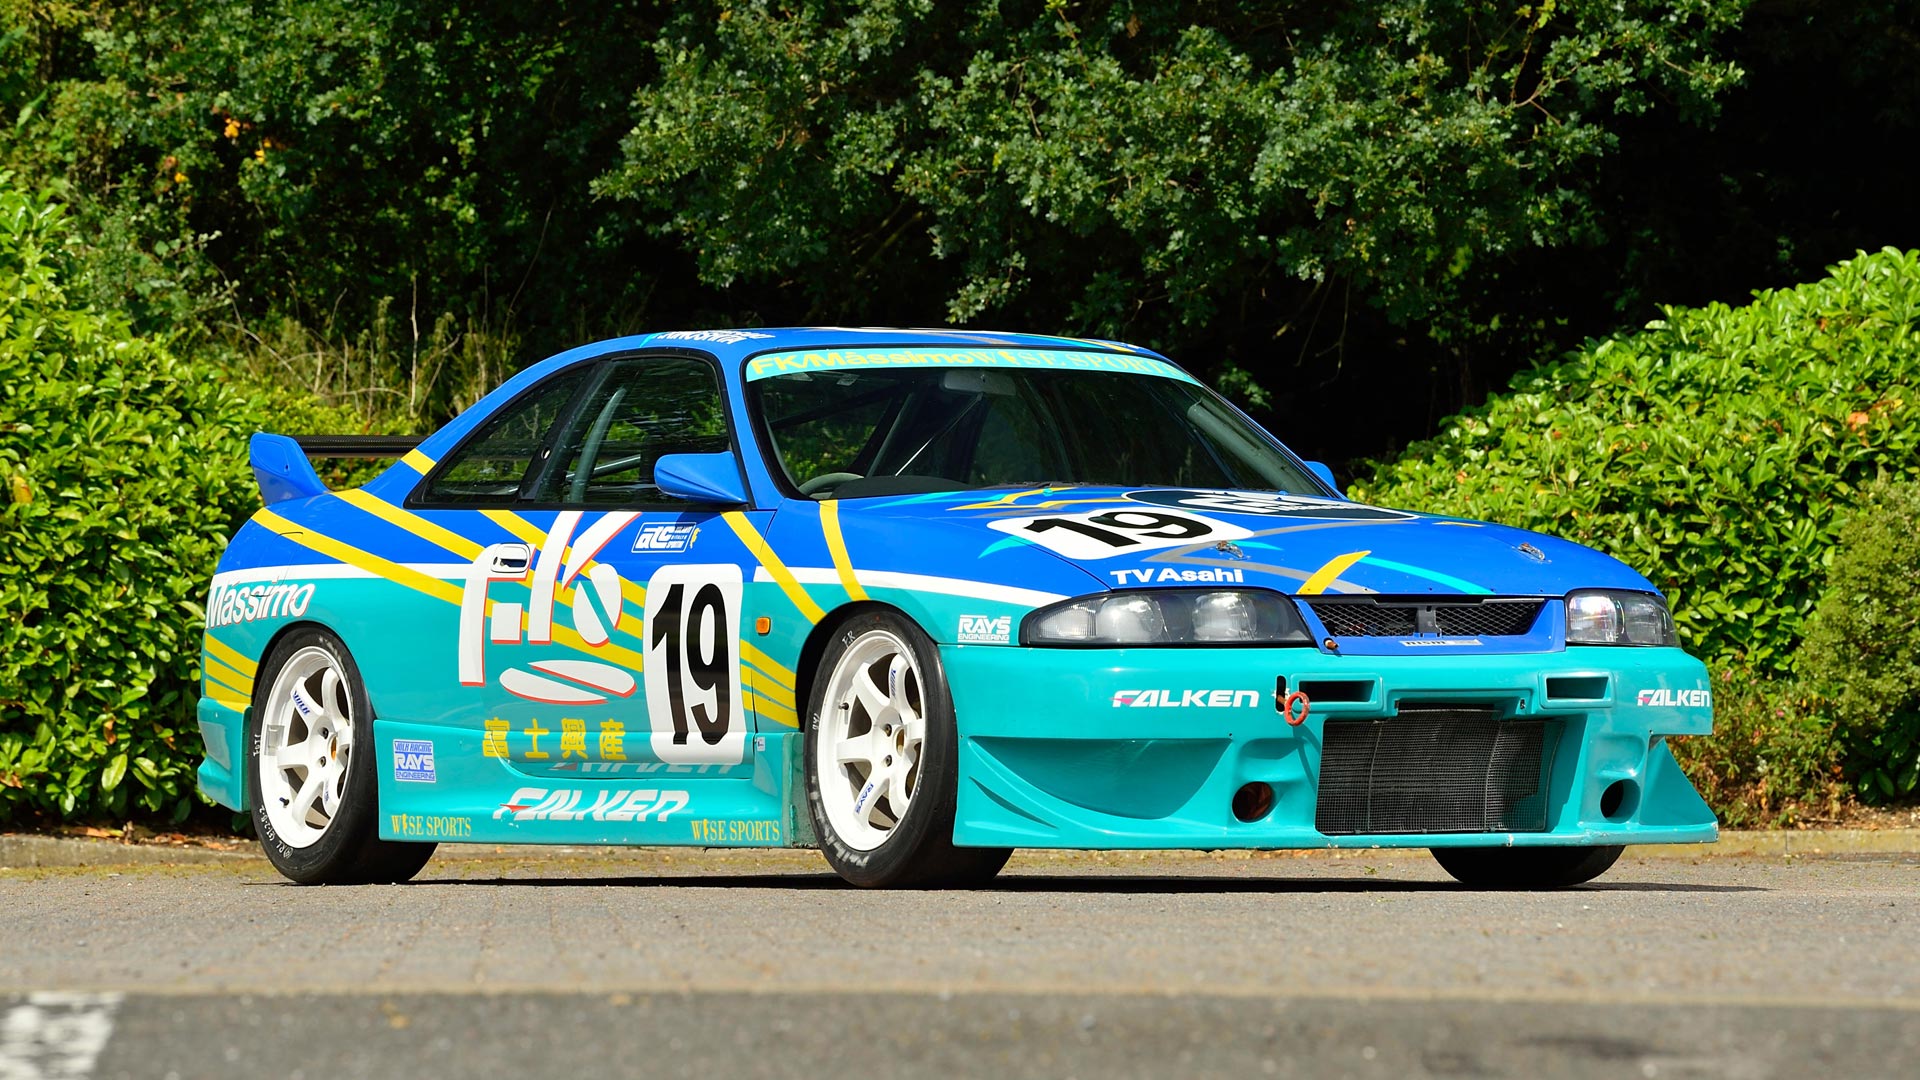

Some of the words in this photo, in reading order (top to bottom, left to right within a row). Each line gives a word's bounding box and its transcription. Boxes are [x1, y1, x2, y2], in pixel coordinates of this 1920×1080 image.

[1023, 511, 1213, 547] 19
[1110, 570, 1155, 584] TV
[1156, 567, 1244, 583] Asahi
[958, 618, 1010, 634] RAYS
[958, 633, 1009, 641] ENGINEERING
[652, 583, 731, 745] 19
[1110, 690, 1260, 708] FALKEN
[1636, 689, 1710, 707] FALKEN
[482, 717, 628, 761] 富士興産
[394, 753, 434, 771] RAYS
[396, 772, 435, 780] ENGINEERING
[492, 787, 690, 822] FALKEN
[427, 815, 471, 837] SPORTS
[729, 820, 780, 841] SPORTS
